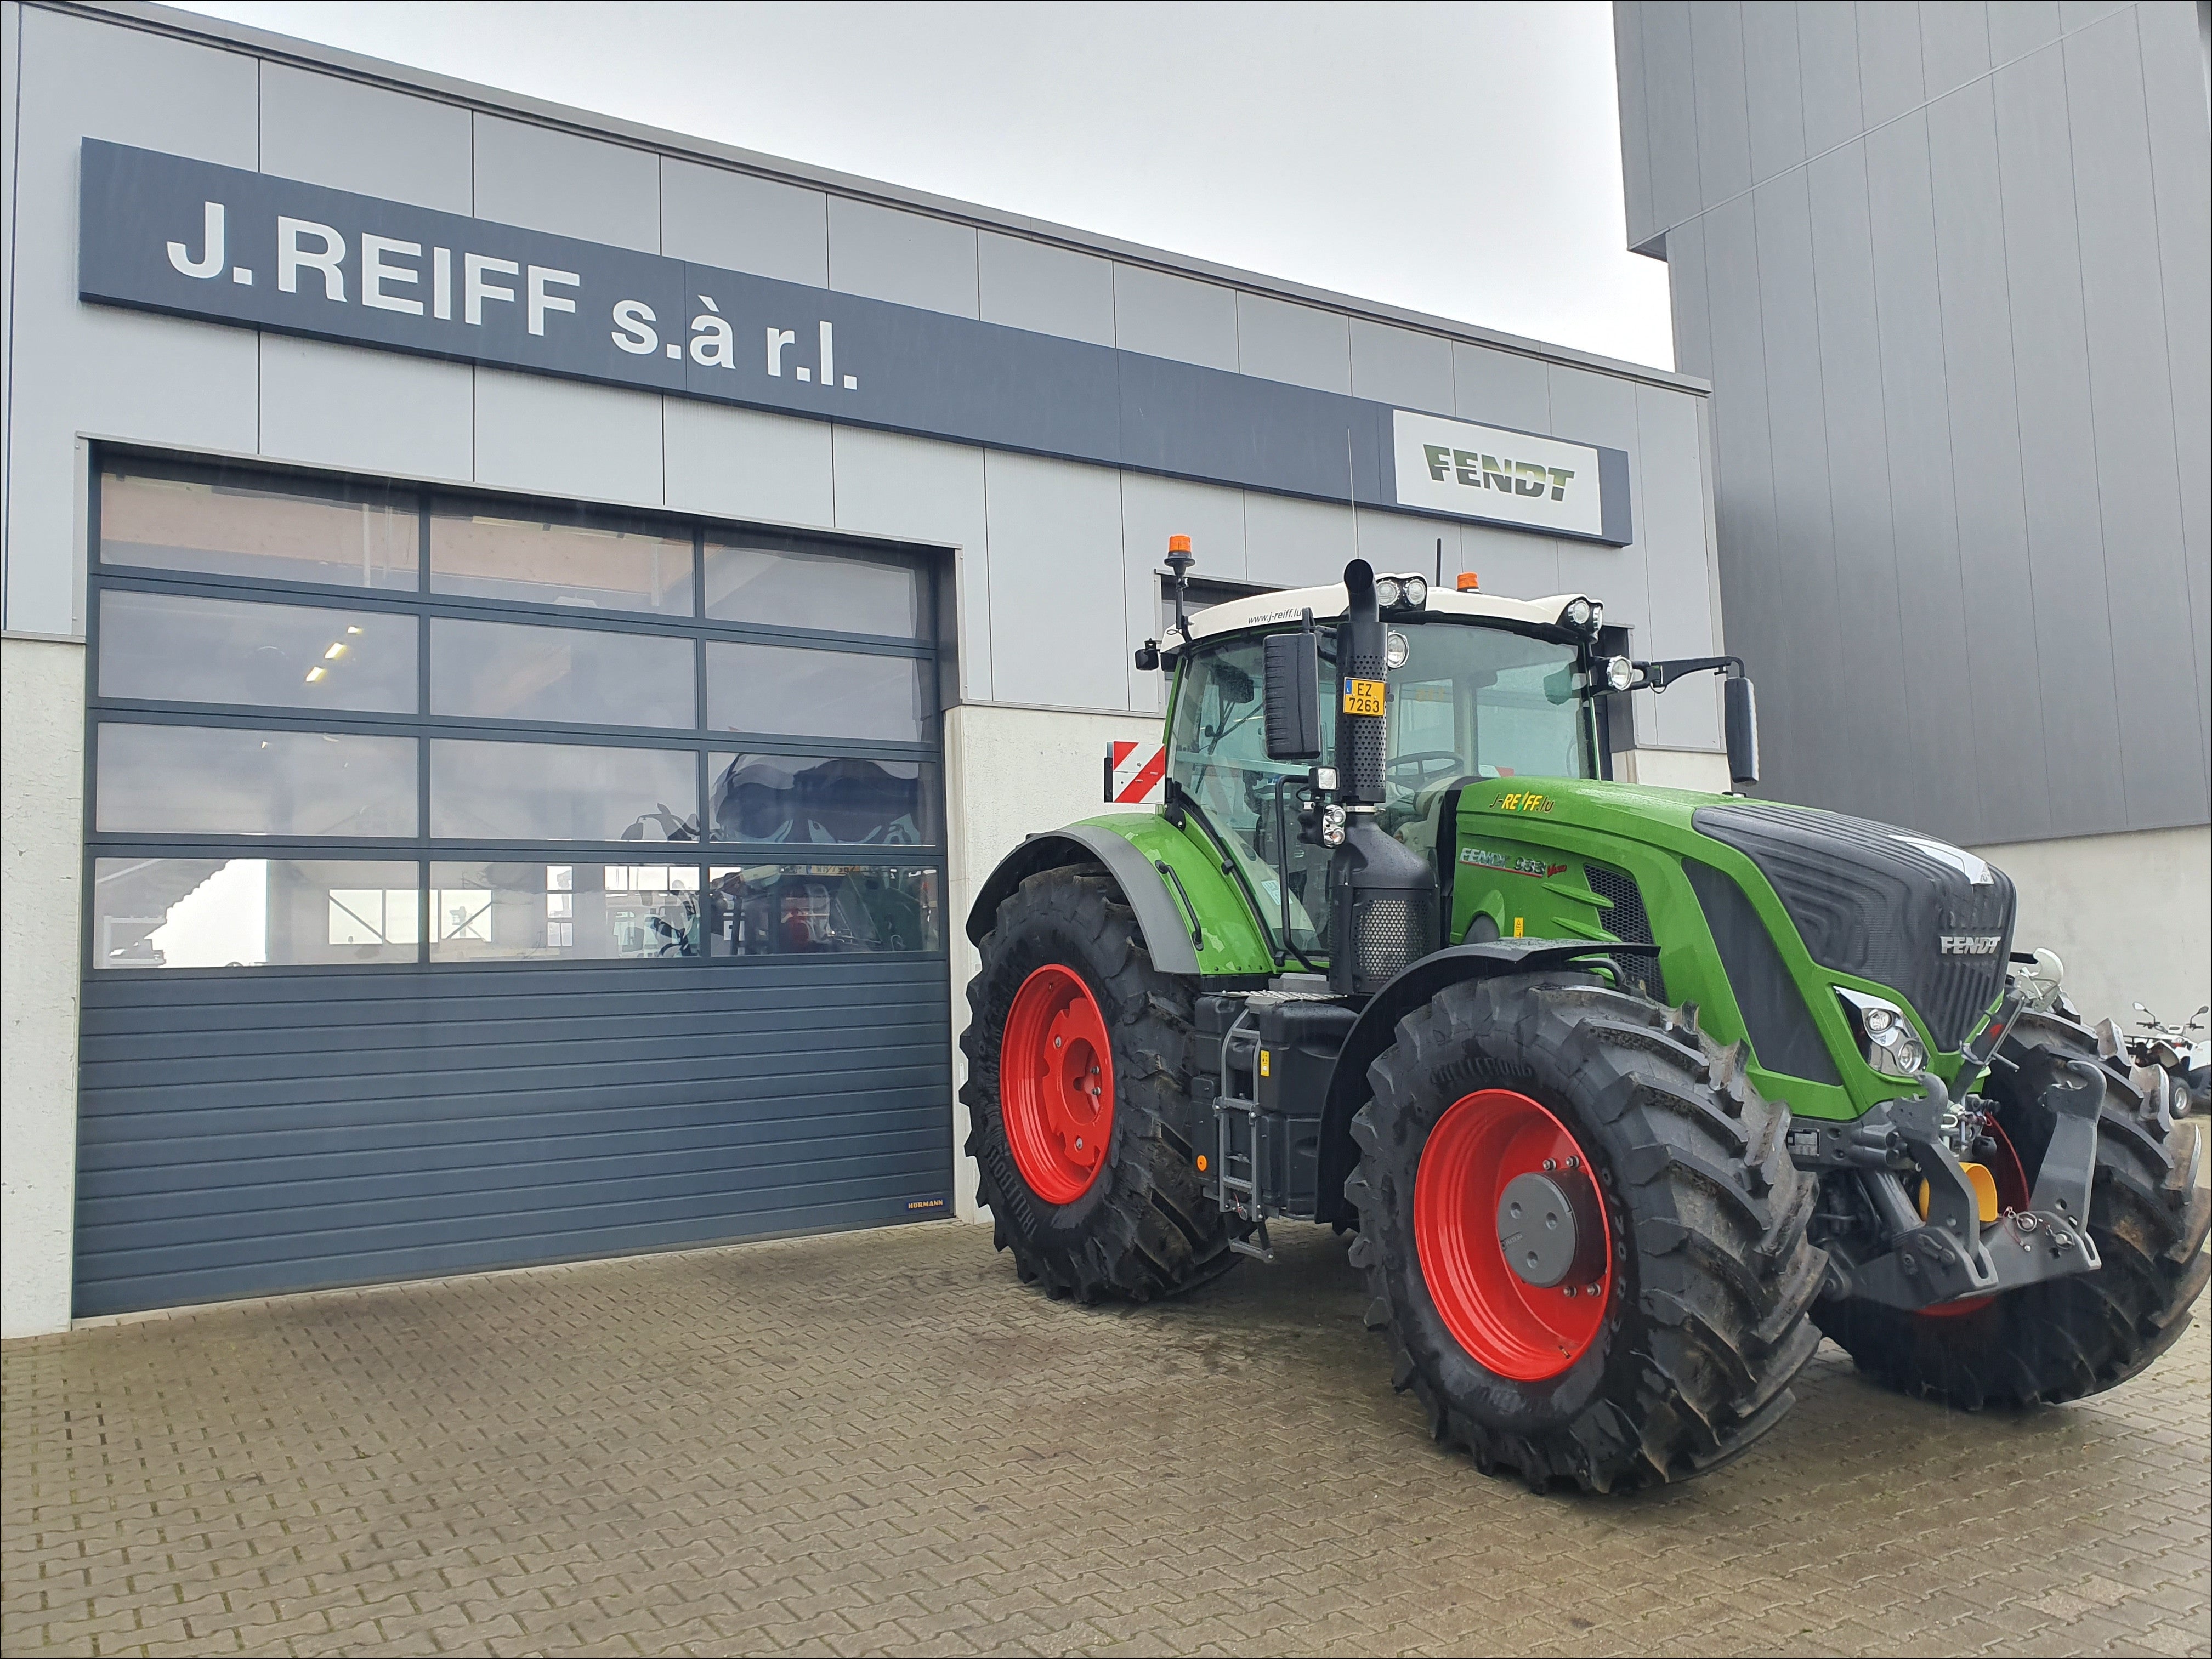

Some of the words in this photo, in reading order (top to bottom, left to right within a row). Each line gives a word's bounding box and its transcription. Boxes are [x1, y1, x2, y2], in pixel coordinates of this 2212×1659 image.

[167, 201, 252, 286] J.
[277, 216, 580, 337] REIFF
[611, 294, 736, 370] s.à
[767, 321, 858, 390] r.l.
[1423, 444, 1575, 502] FENDT
[1248, 608, 1302, 624] www.j-reiff.lu
[1357, 683, 1372, 697] EZ
[1349, 697, 1380, 713] 7263
[1939, 936, 2001, 955] FENDT
